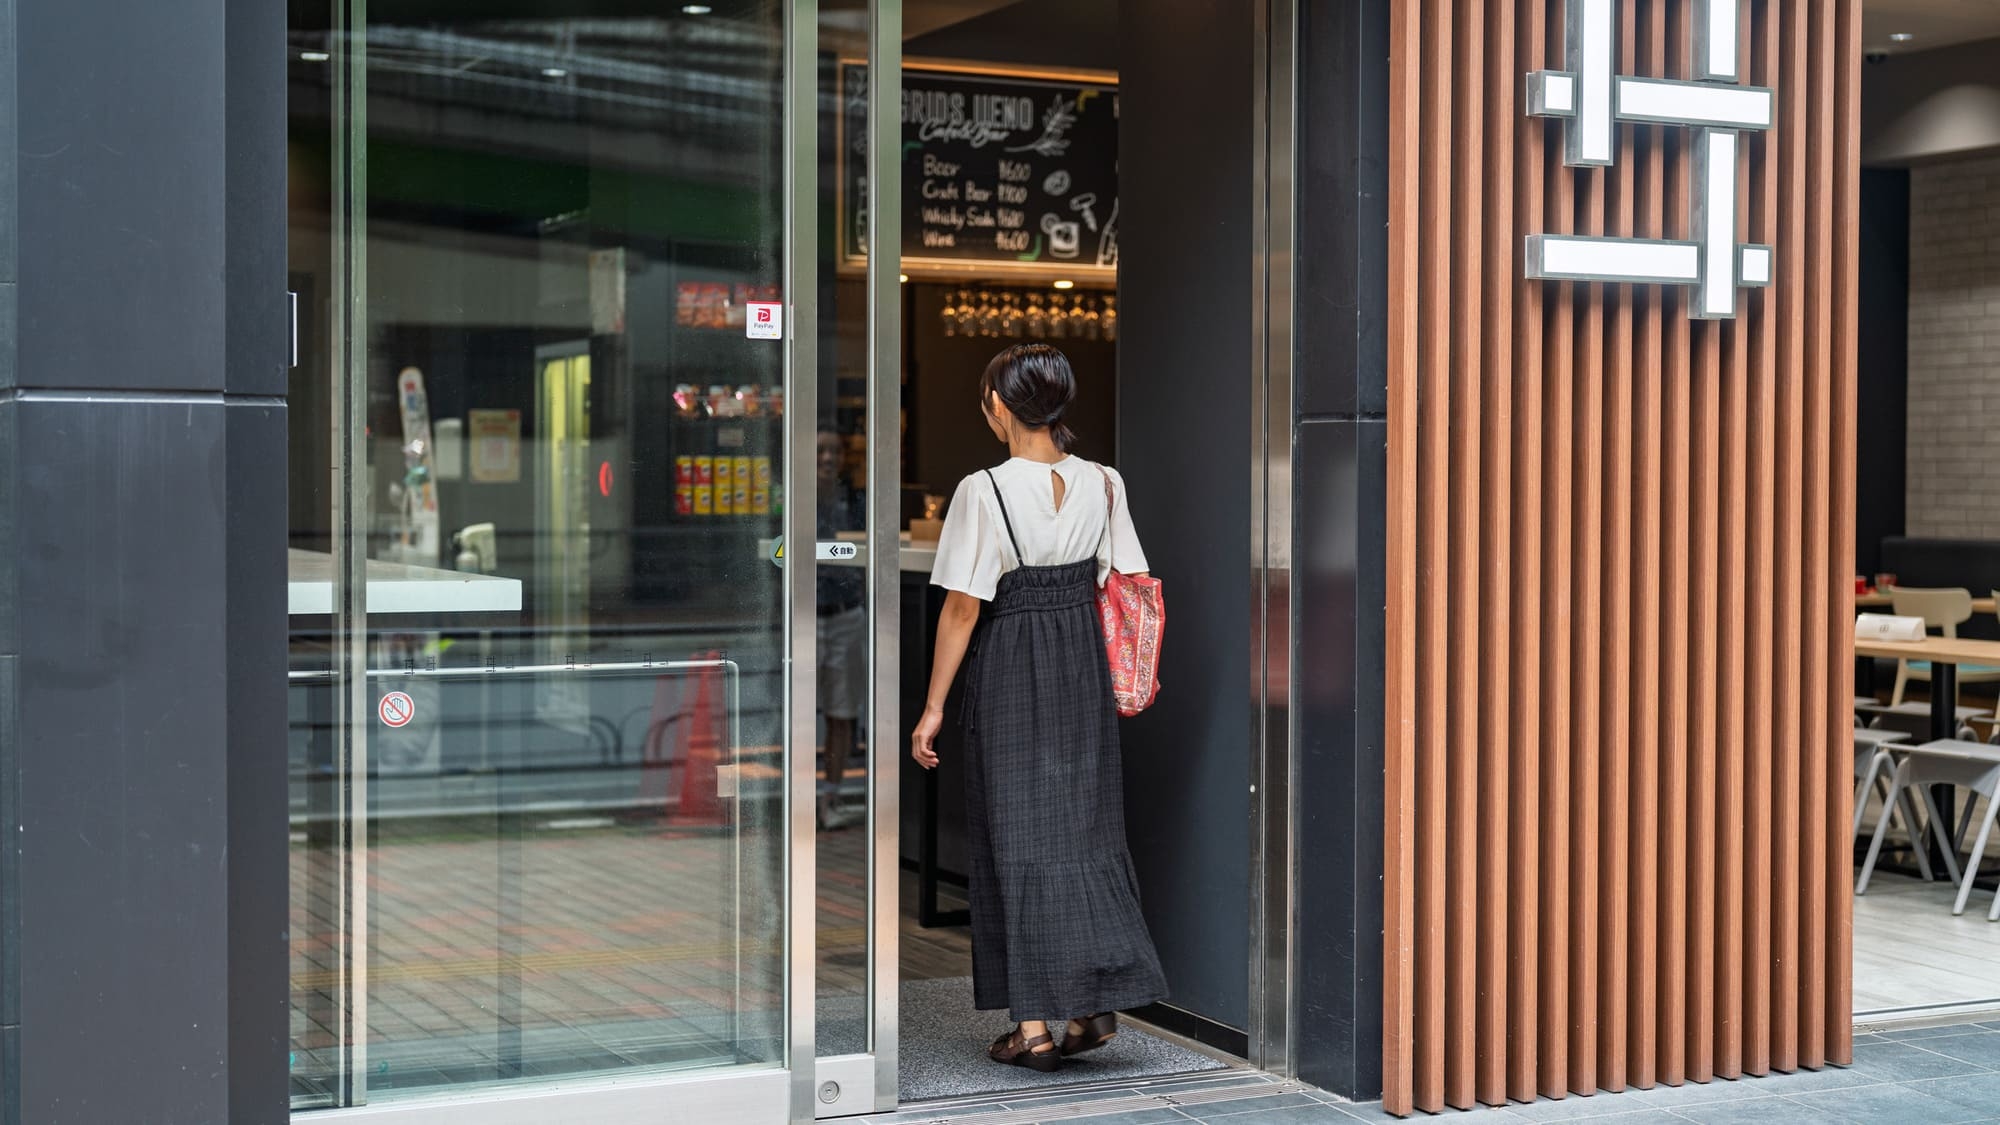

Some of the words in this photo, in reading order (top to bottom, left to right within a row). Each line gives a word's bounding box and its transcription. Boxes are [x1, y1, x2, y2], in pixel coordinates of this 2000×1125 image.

[973, 94, 1034, 130] UENO
[923, 153, 961, 176] Beer
[922, 179, 959, 200] Craft
[965, 180, 993, 202] Beer
[966, 206, 996, 227] Soda
[922, 229, 956, 247] Wine
[840, 547, 854, 555] 自動
